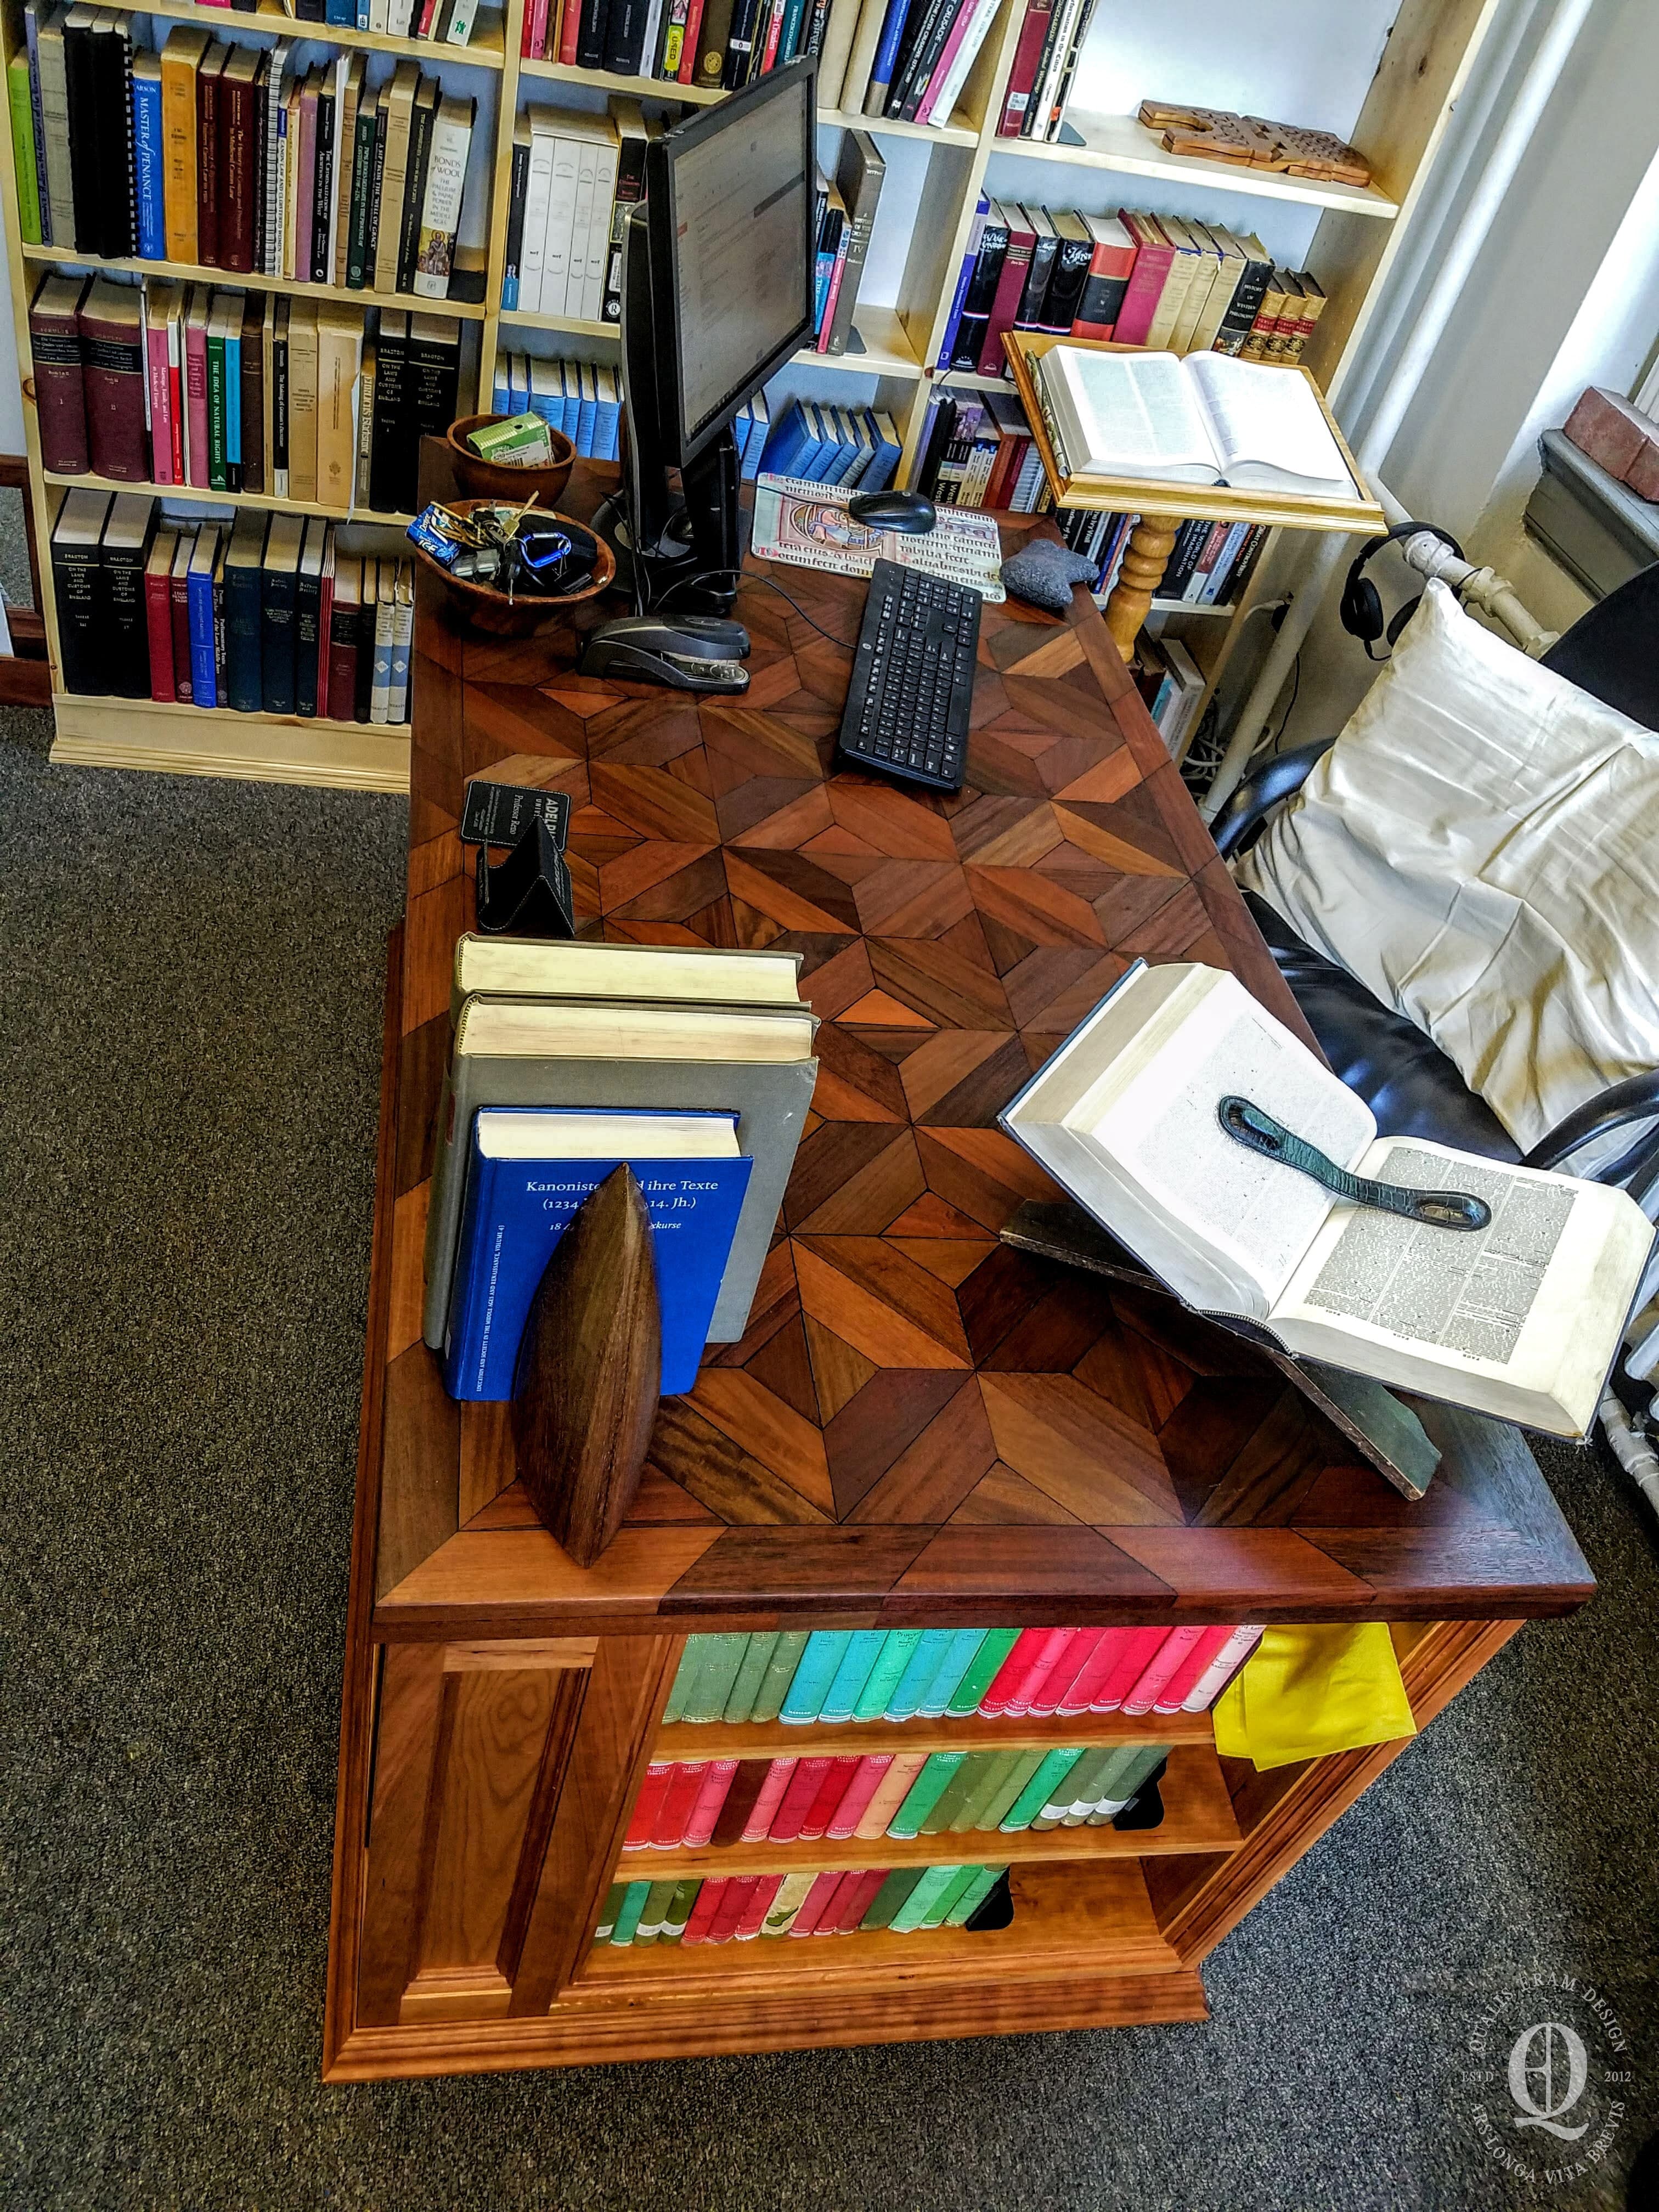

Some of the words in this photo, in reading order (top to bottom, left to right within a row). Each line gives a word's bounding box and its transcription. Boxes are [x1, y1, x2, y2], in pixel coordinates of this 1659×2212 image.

[924, 12, 936, 31] LATER
[934, 6, 953, 43] CRUSADE
[669, 35, 678, 60] USED
[140, 97, 150, 139] MASTER
[136, 139, 155, 156] of
[434, 155, 461, 167] BONDS
[142, 153, 152, 201] PENANCE
[436, 166, 461, 178] WOOL
[432, 184, 456, 193] PALLIUM
[432, 198, 453, 206] POWER
[373, 217, 379, 225] OF
[853, 245, 864, 253] IV
[213, 394, 220, 404] OF
[935, 482, 946, 503] West
[946, 484, 957, 504] West
[1087, 519, 1097, 531] Ivy
[1194, 520, 1204, 533] THE
[1200, 520, 1210, 535] THE
[1084, 529, 1093, 544] Wall
[417, 539, 439, 554] ICE
[1190, 534, 1205, 560] WORLD
[1175, 533, 1198, 578] IMAGINATION
[1237, 539, 1256, 578] CONTROVERSY
[1186, 560, 1194, 571] OF
[647, 1181, 676, 1192] ihre
[679, 1181, 719, 1192] Texte
[543, 1198, 579, 1210] (1234
[670, 1197, 697, 1209] Jh.)
[476, 1368, 484, 1392] EDUCATION
[490, 1251, 500, 1285] RENAISSANCE,
[495, 1231, 503, 1251] VOLUME
